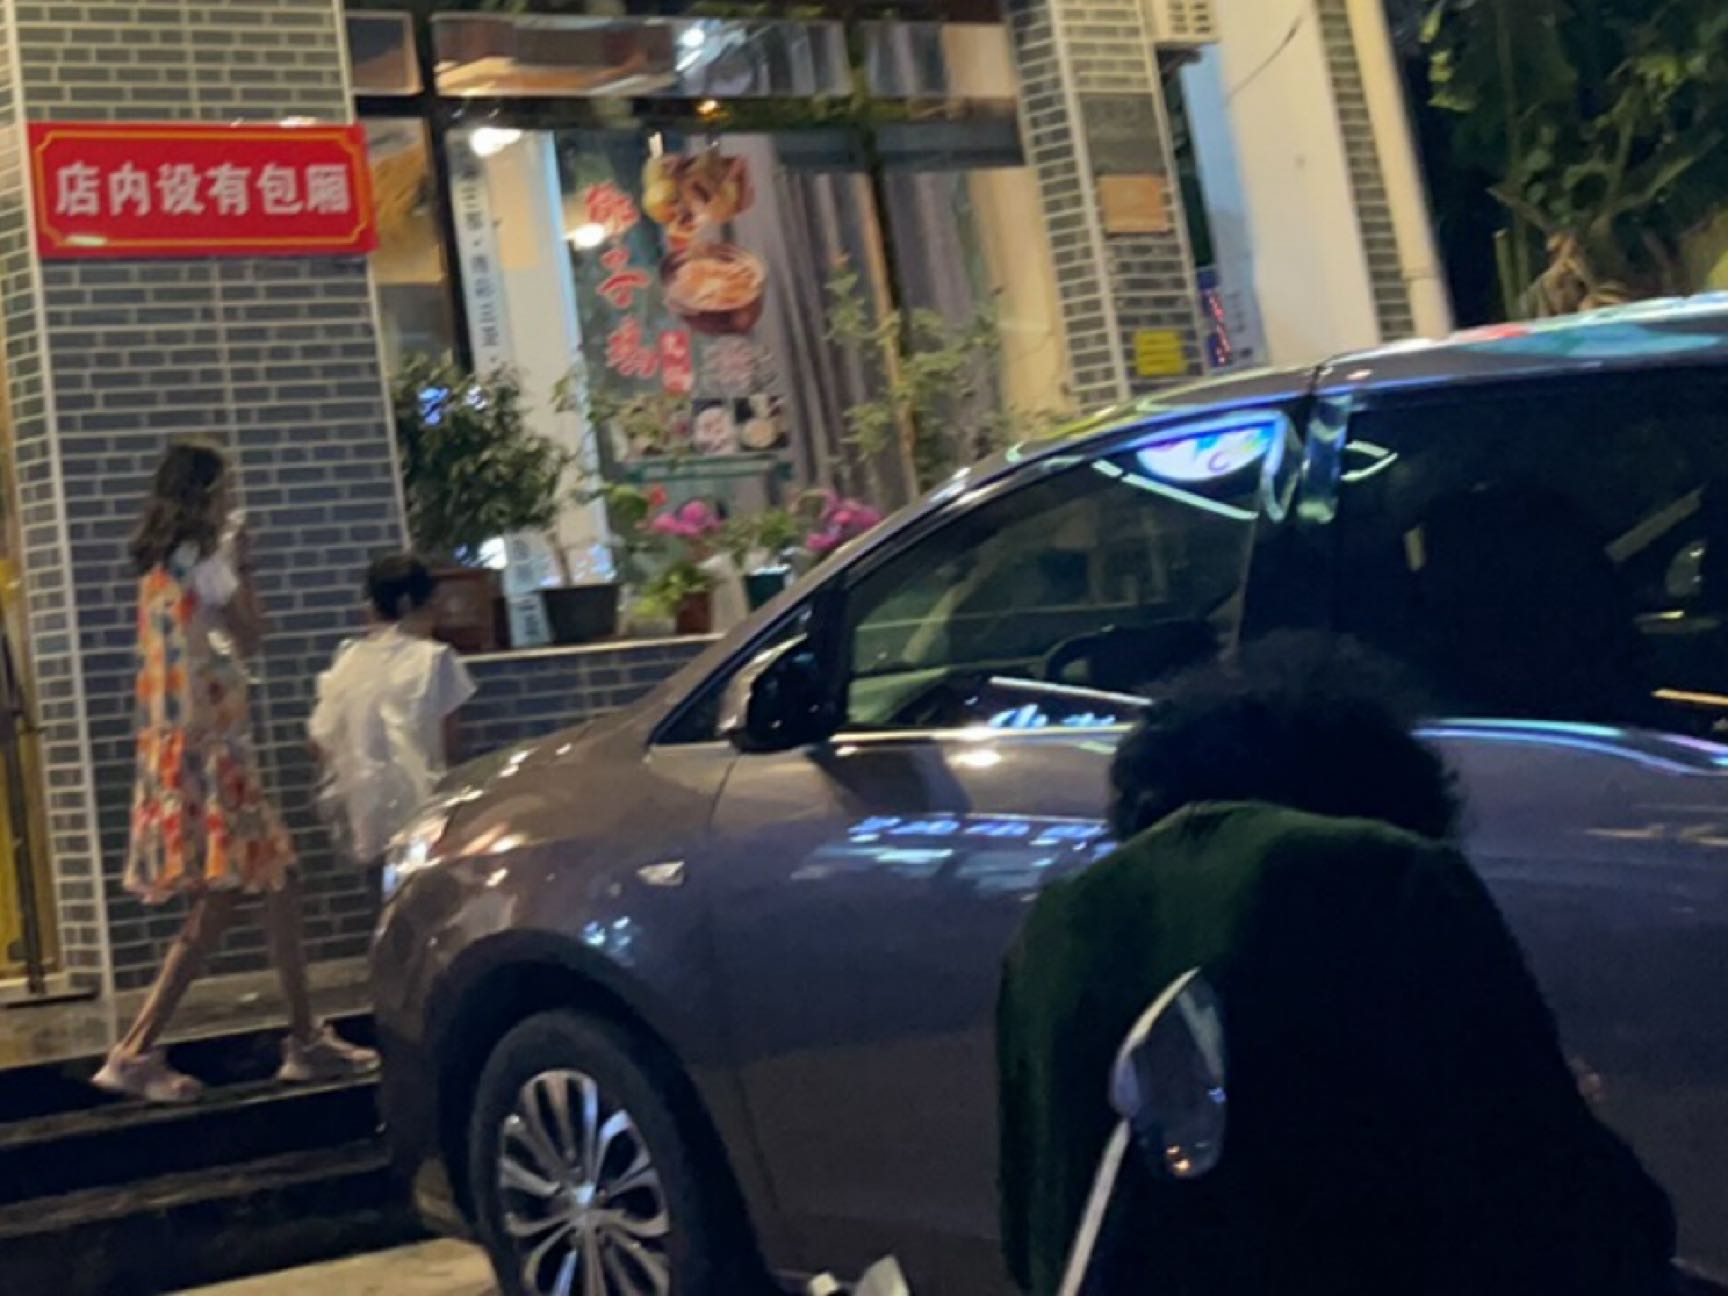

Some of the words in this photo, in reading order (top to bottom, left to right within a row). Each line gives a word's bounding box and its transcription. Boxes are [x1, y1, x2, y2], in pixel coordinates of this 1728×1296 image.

[54, 160, 352, 217] 店内设有包厢
